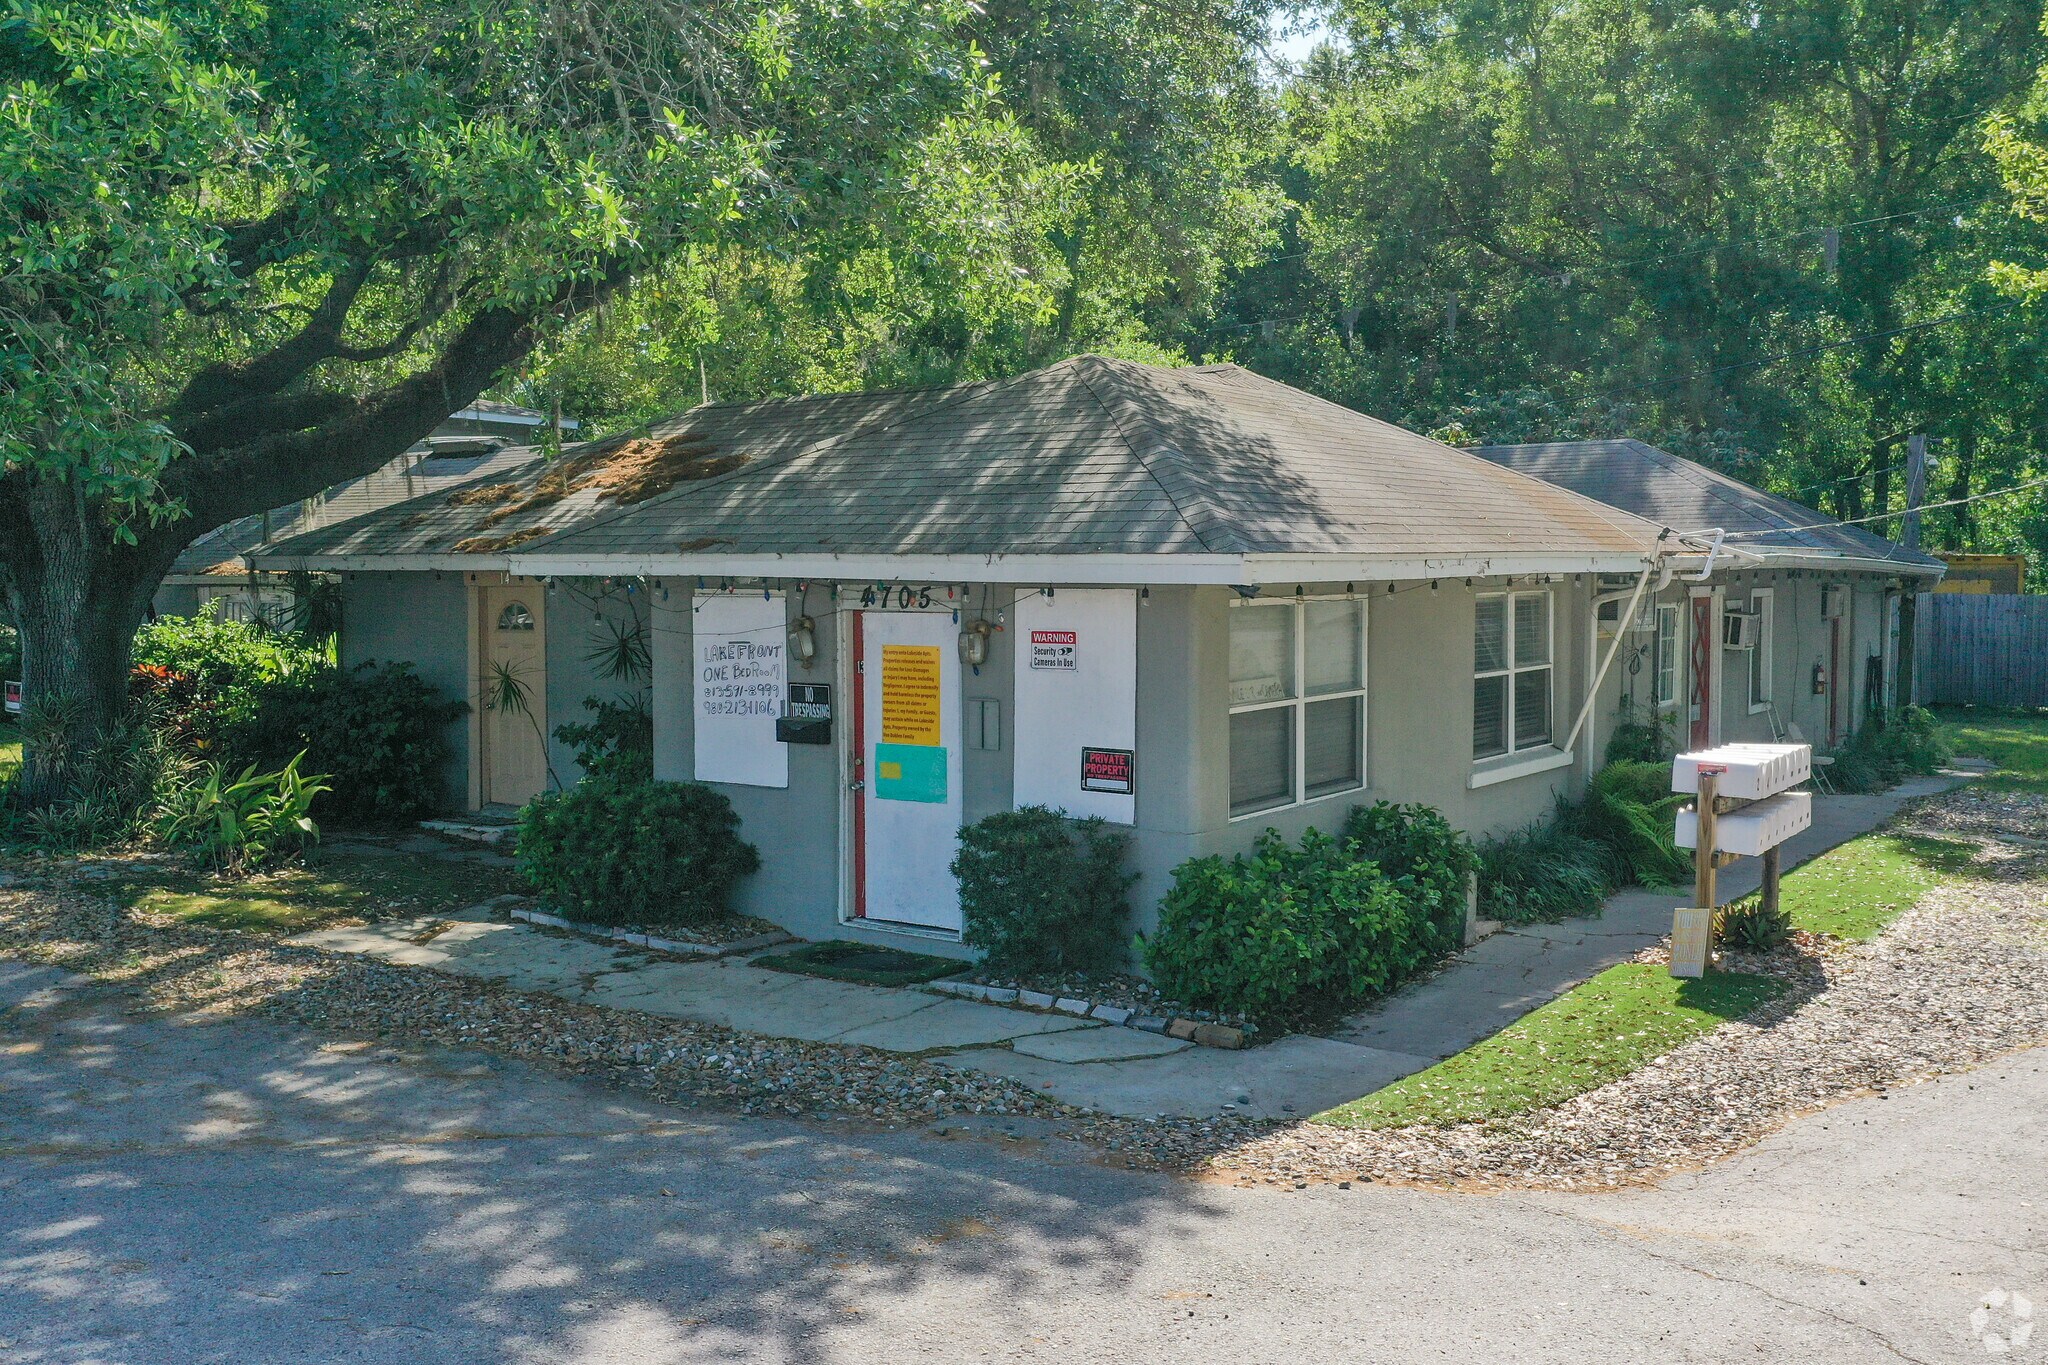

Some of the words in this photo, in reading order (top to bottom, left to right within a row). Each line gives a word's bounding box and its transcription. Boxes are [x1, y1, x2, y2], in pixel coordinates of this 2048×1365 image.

[860, 585, 931, 609] 4705
[1033, 633, 1074, 643] WARNING
[1034, 646, 1056, 657] Security
[1034, 657, 1056, 667] Cameras
[1064, 658, 1073, 667] Use
[704, 665, 728, 682] ONE
[805, 686, 814, 702] NO
[791, 702, 830, 718] TRESPASSING
[1090, 752, 1125, 765] PRIVATE
[1086, 763, 1128, 776] PROPERTY
